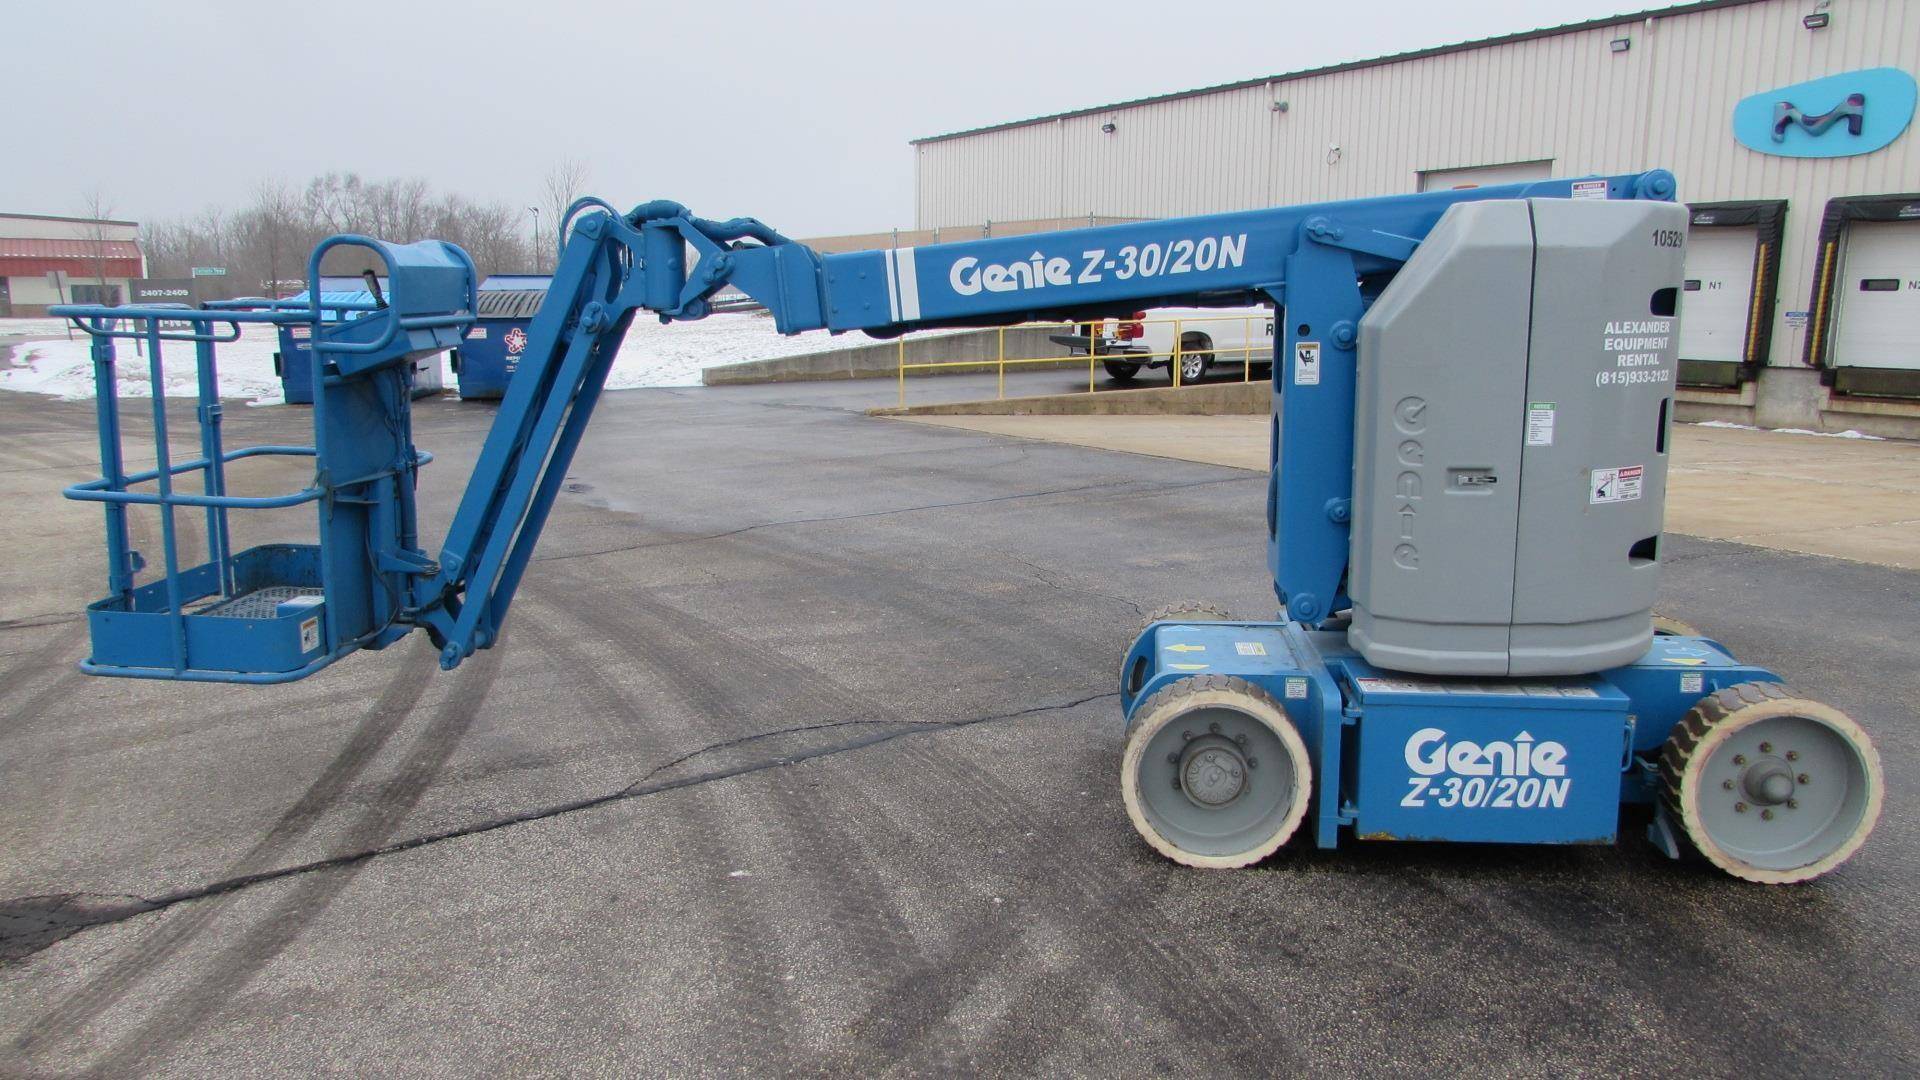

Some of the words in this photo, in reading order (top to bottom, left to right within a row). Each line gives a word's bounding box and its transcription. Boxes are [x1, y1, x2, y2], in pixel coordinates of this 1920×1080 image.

[949, 251, 1072, 296] Genie
[1077, 234, 1248, 285] Z-30/20N
[1709, 281, 1722, 290] N1
[141, 289, 189, 297] 2407-2409
[1604, 321, 1671, 335] ALEXANDER
[1604, 337, 1669, 351] EQUIPMENT
[1617, 353, 1660, 367] RENTAL
[1595, 369, 1670, 388] (815)933-2122
[1404, 727, 1568, 776] Genie
[1400, 777, 1572, 808] Z-30/20N
